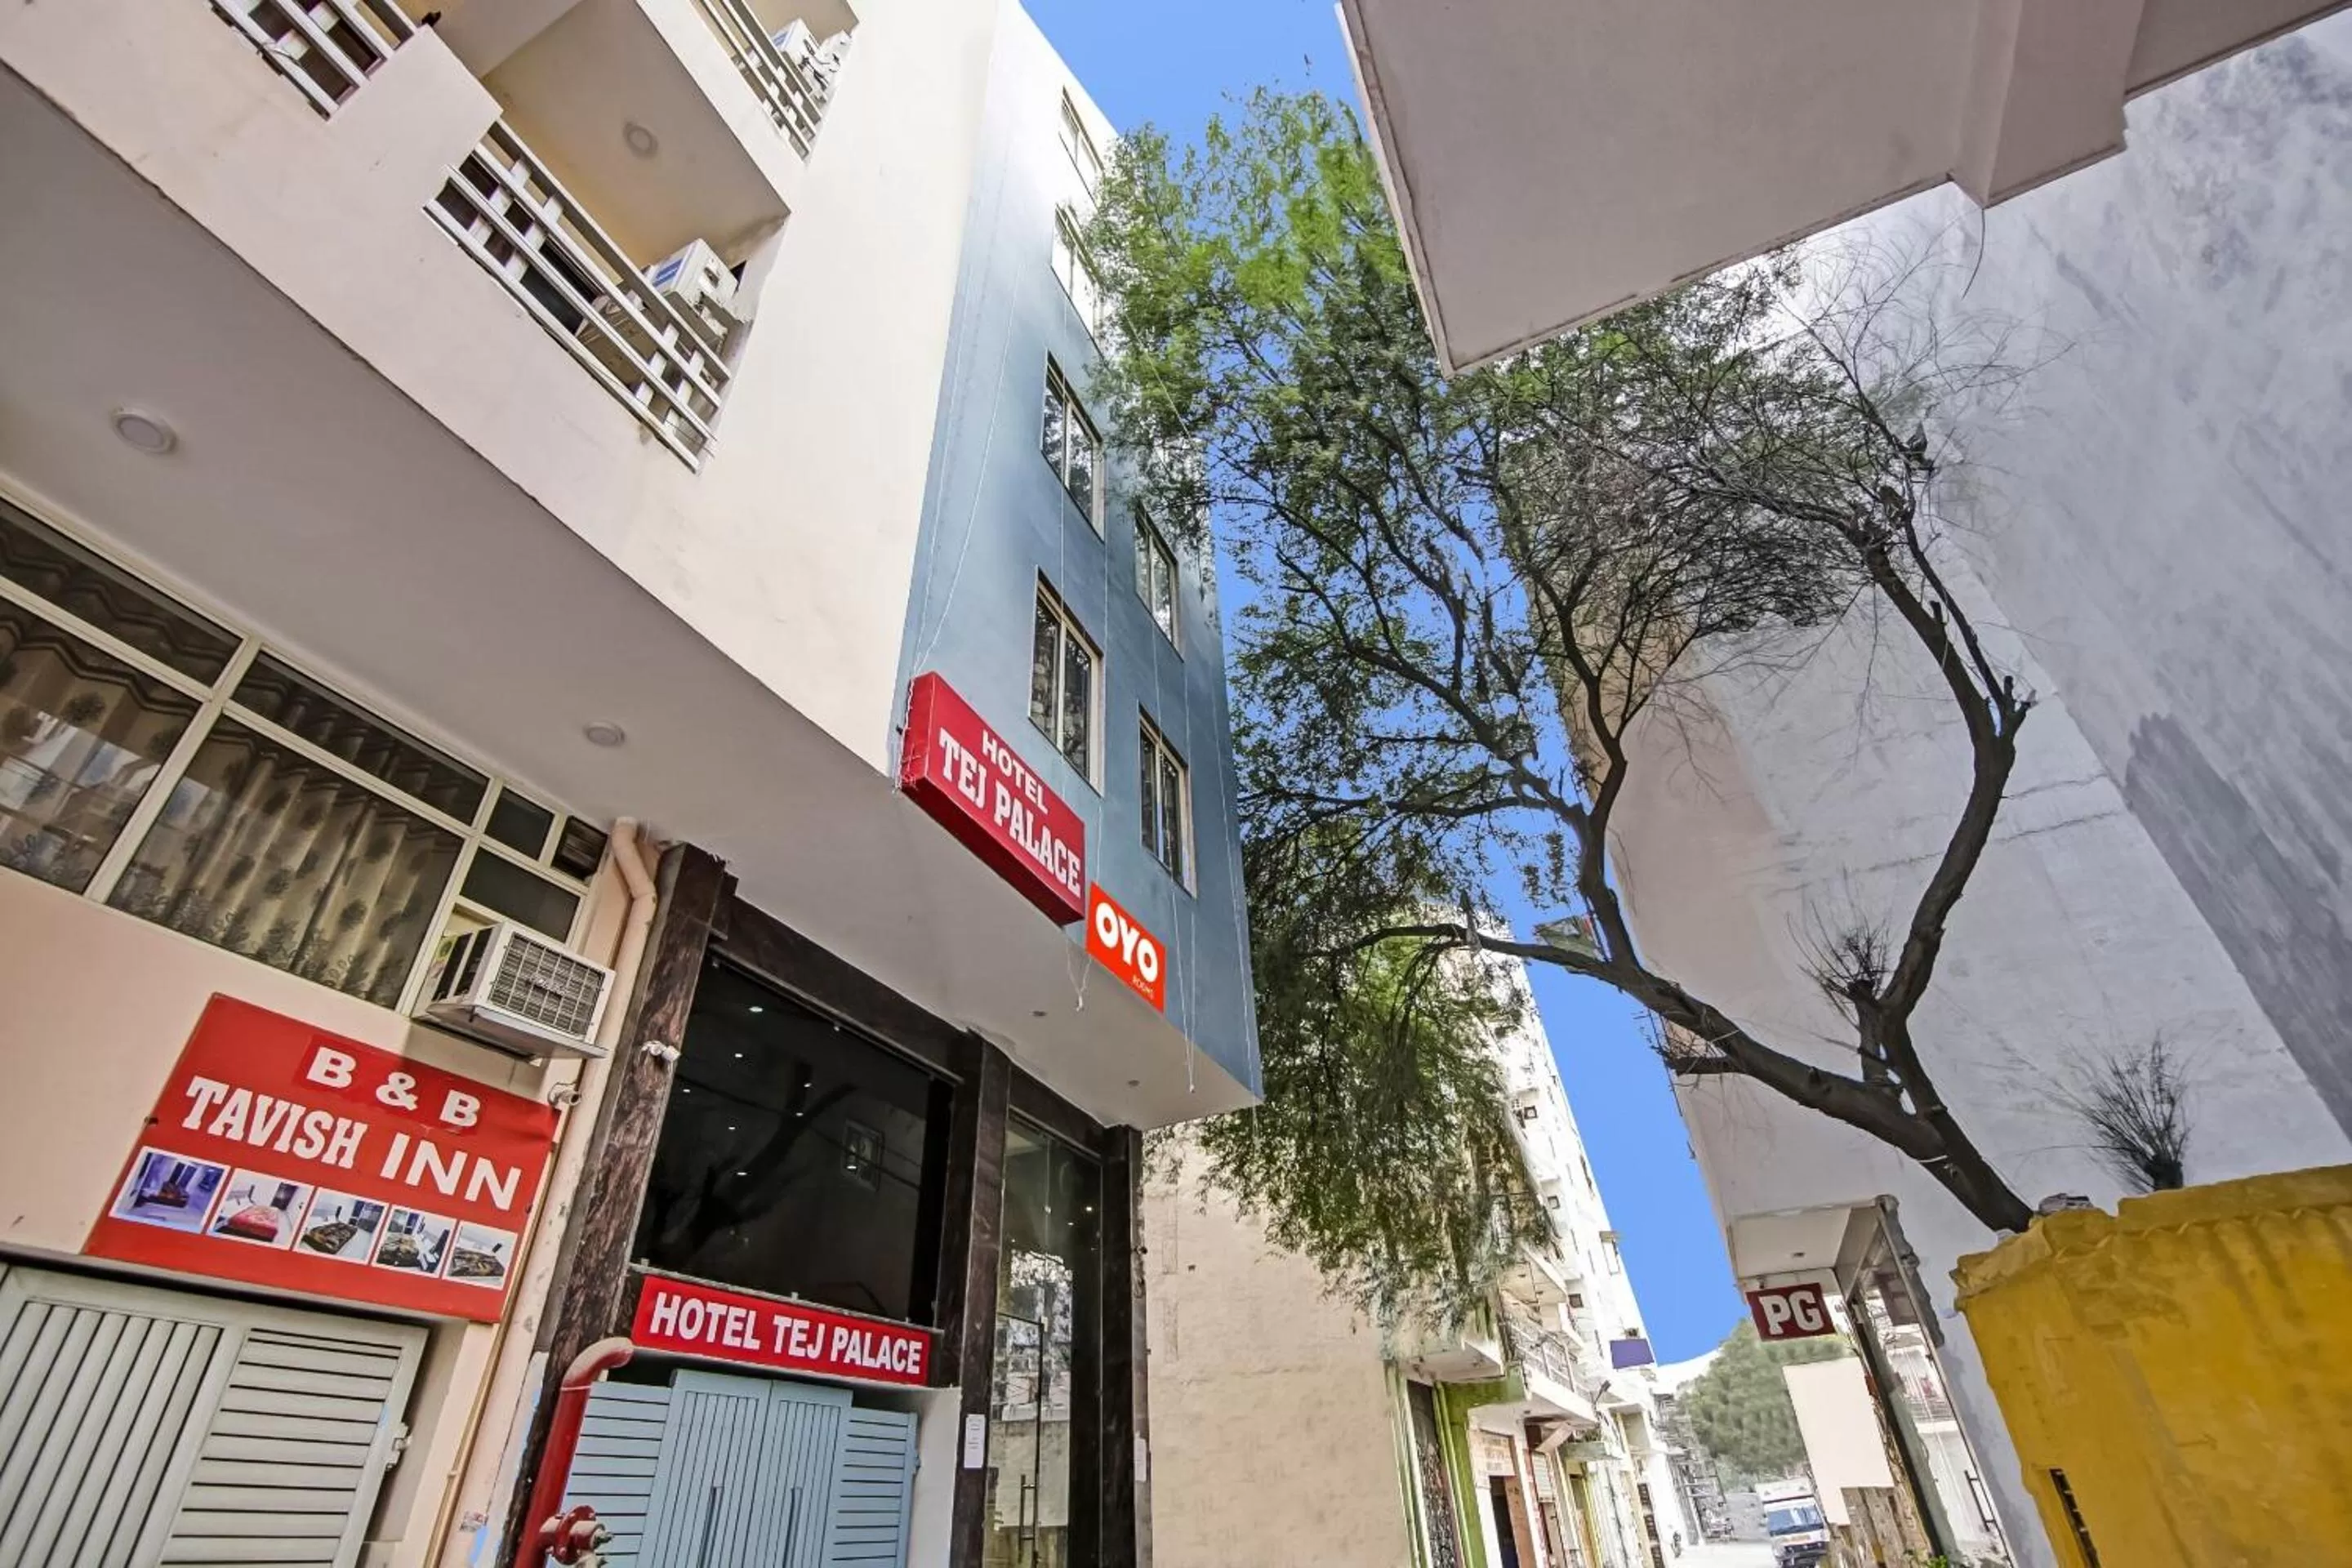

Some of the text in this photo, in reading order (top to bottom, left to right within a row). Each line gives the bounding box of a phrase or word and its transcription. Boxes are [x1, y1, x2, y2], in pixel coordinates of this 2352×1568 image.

[938, 727, 1080, 898] TEJ PALACE
[982, 730, 1049, 814] HOTEL
[1095, 902, 1158, 982] OYO
[306, 1047, 481, 1128] B & B
[181, 1076, 522, 1212] TAVISH INN
[650, 1292, 923, 1374] HOTEL TEJ PALACE
[1758, 1290, 1824, 1335] PG
